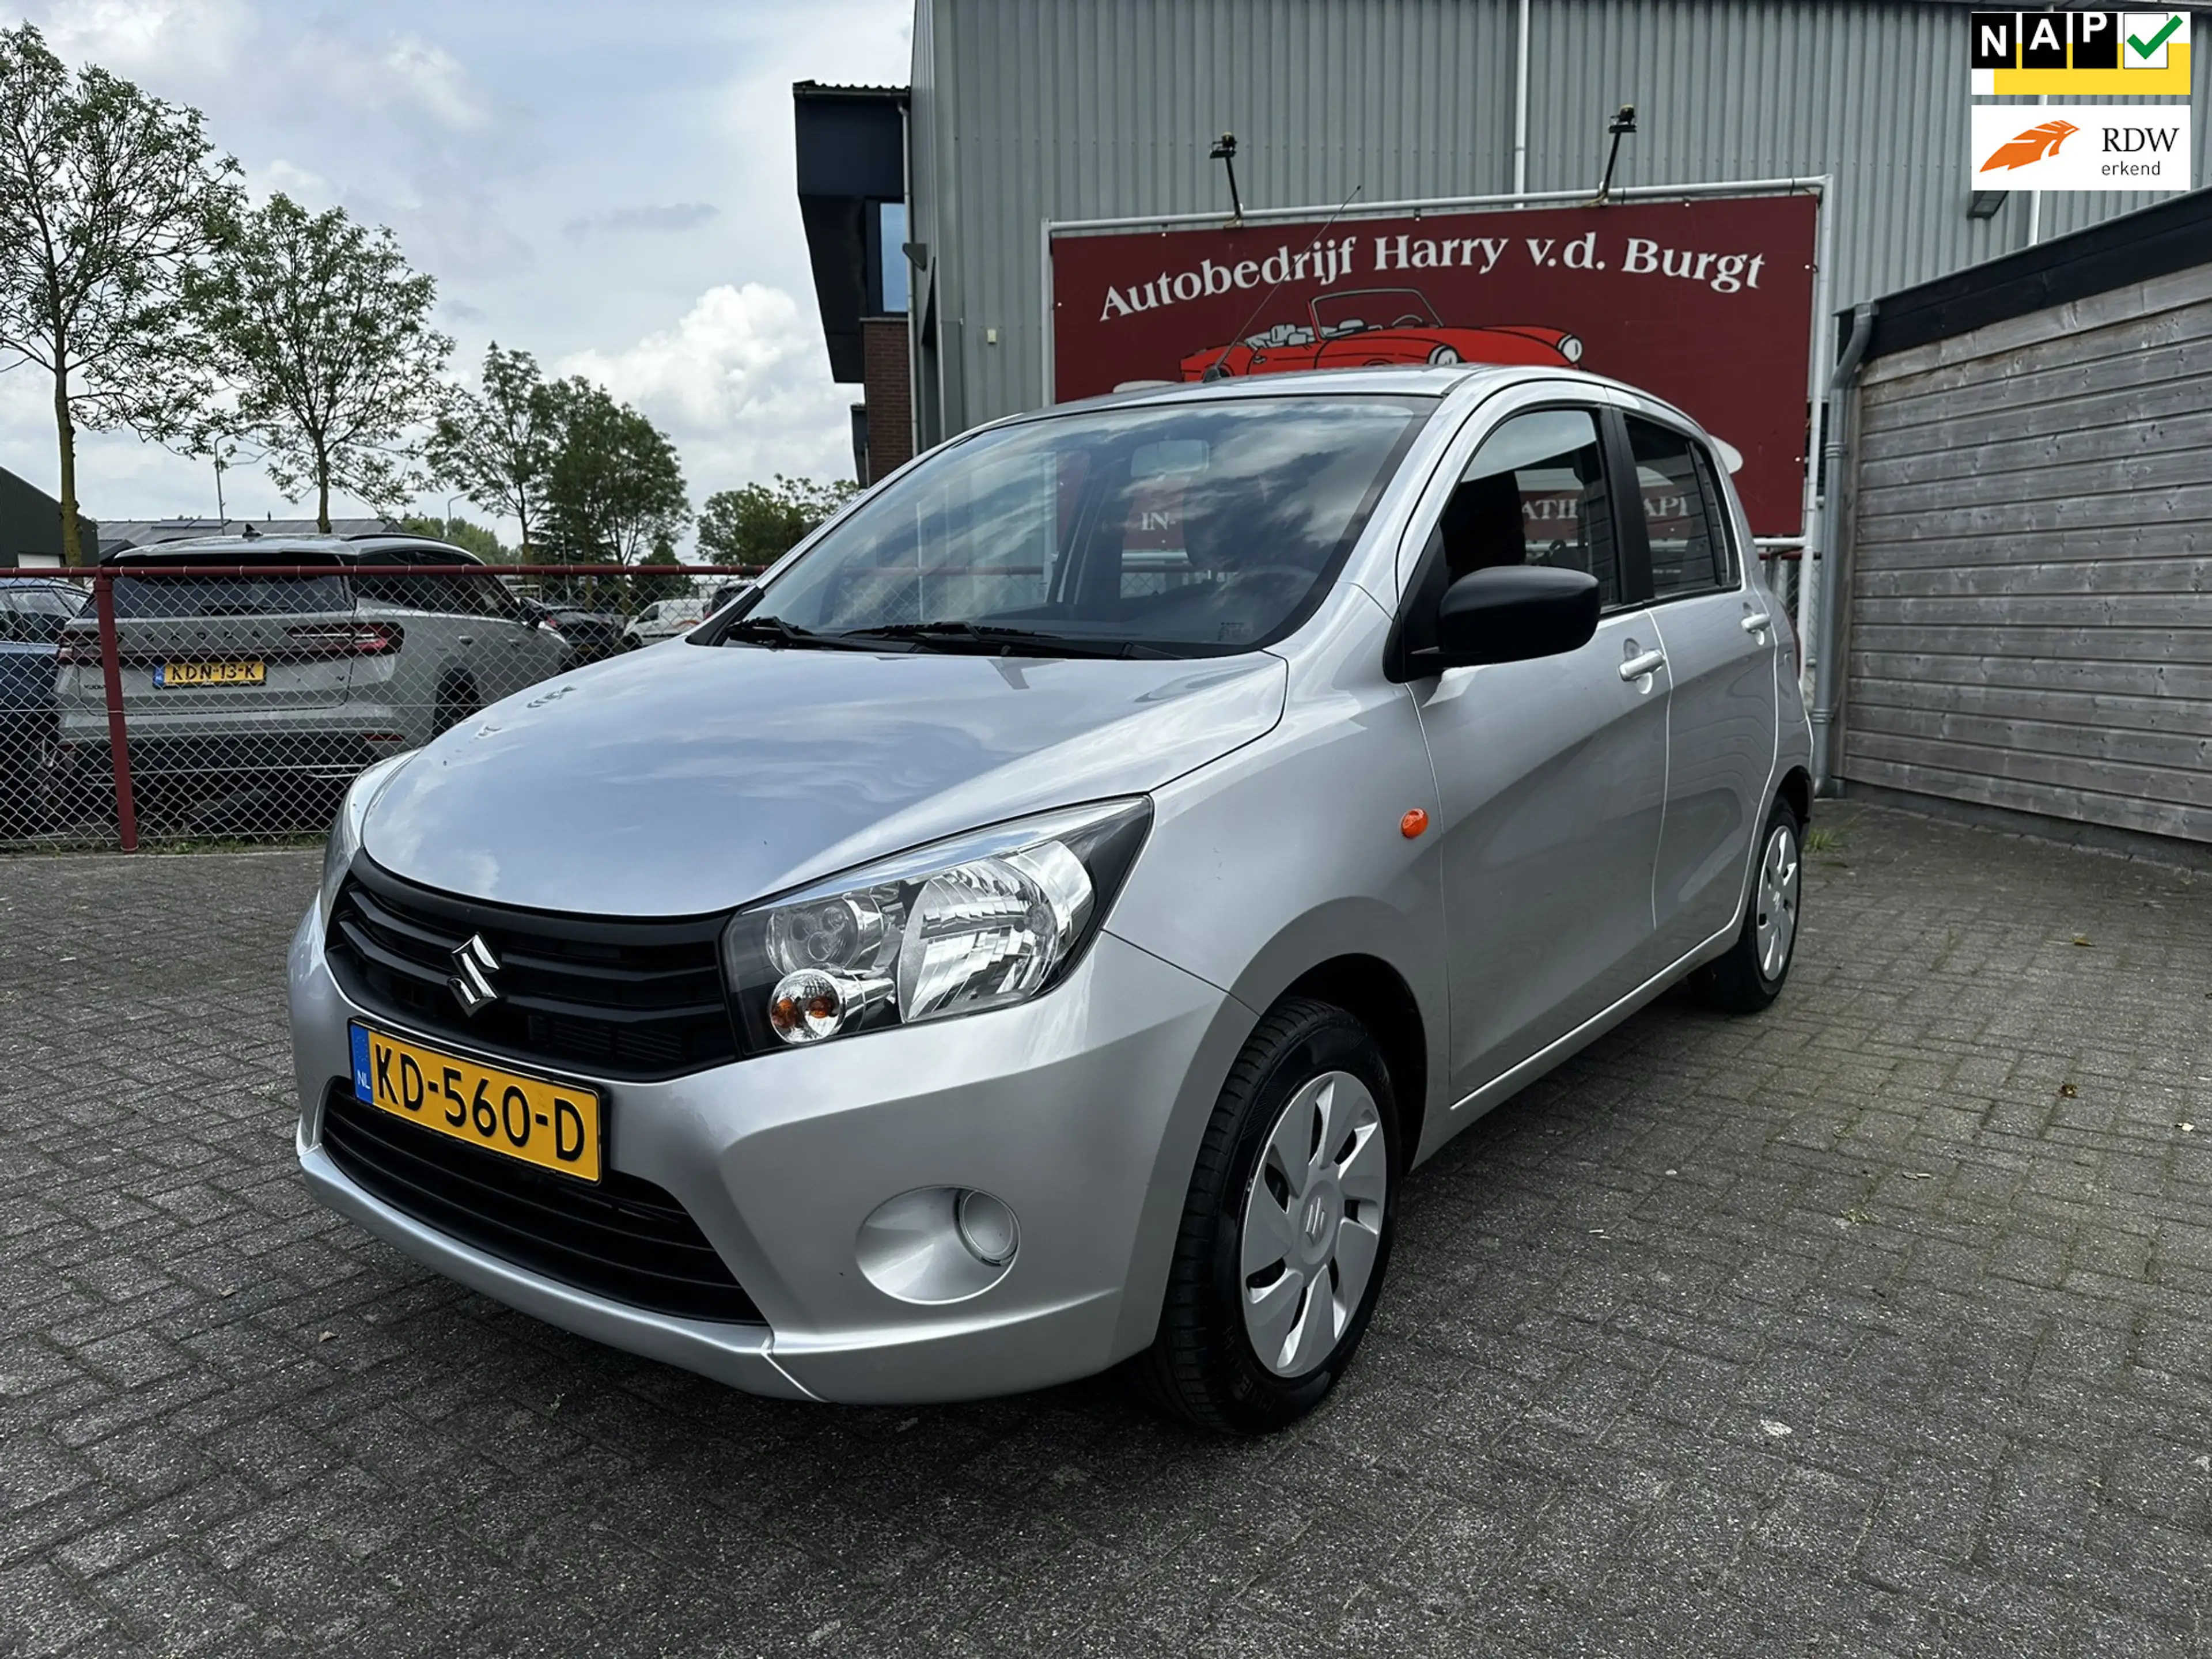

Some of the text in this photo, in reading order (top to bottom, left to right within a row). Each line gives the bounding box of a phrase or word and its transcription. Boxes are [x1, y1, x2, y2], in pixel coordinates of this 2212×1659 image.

[1099, 232, 1766, 321] Autobedrijf Harry v.d. Burgt
[172, 664, 255, 680] KDN-13-K
[357, 1069, 370, 1090] NL
[375, 1043, 585, 1162] KD-560-D
